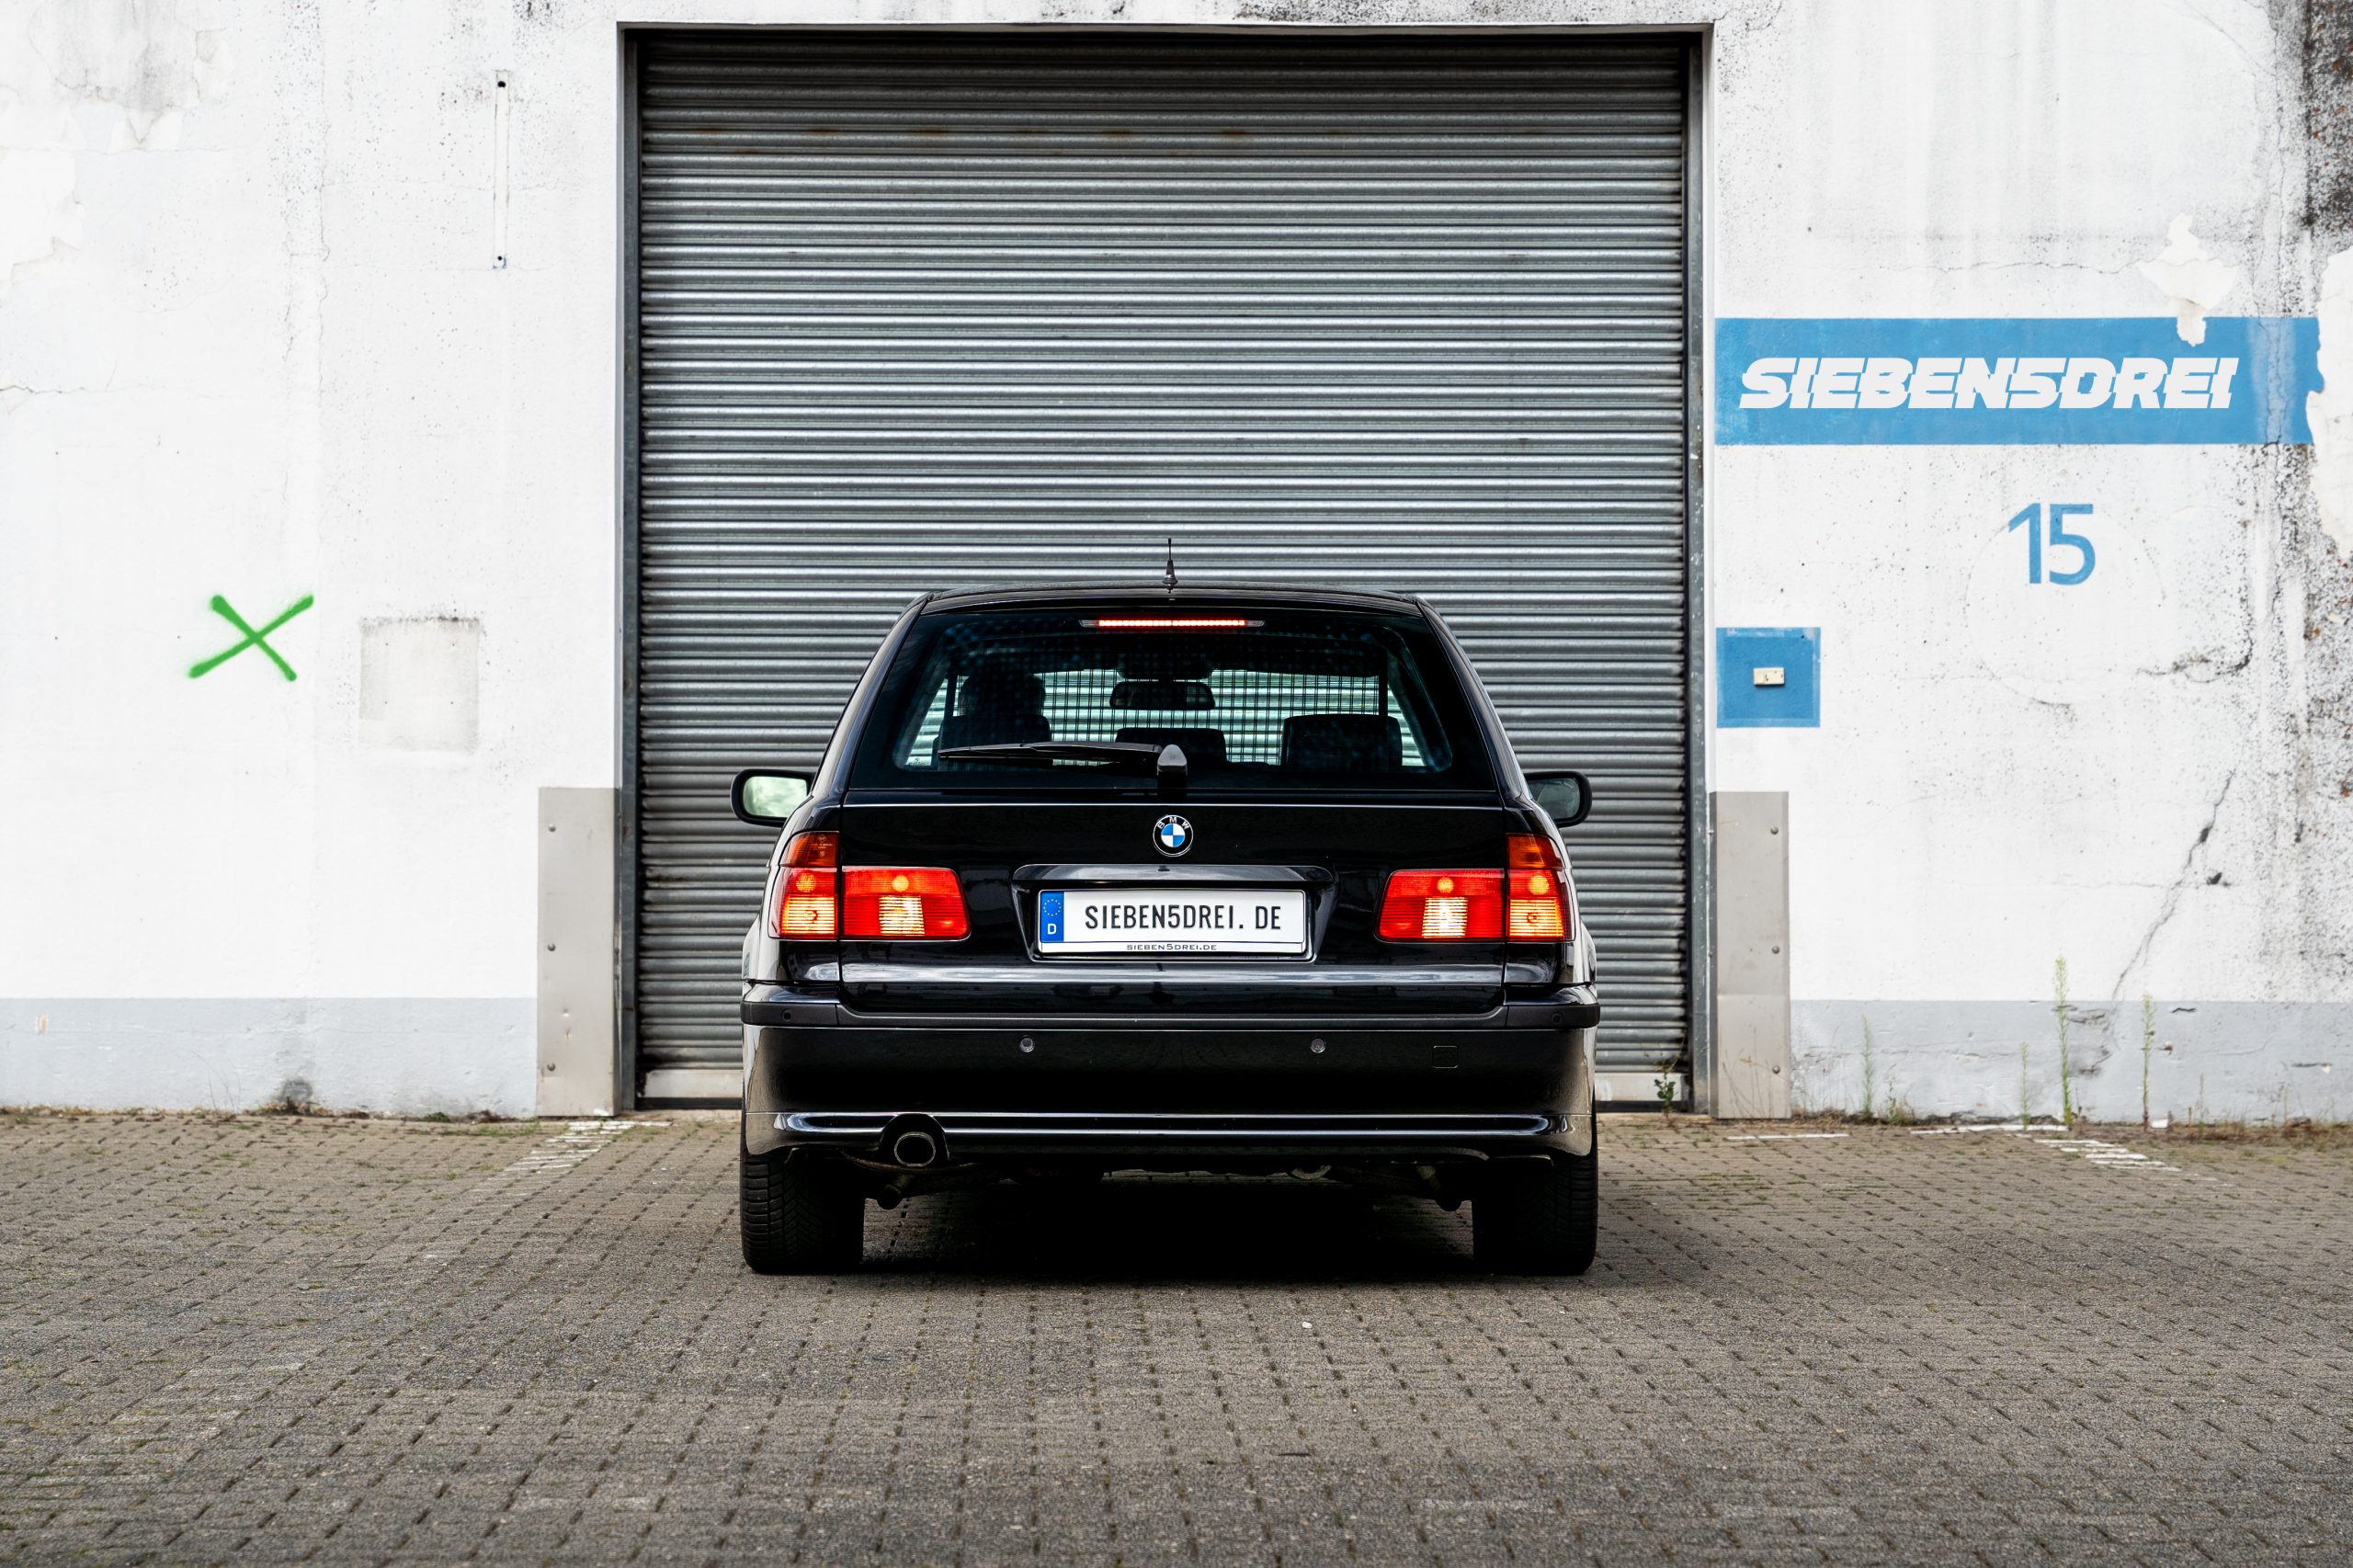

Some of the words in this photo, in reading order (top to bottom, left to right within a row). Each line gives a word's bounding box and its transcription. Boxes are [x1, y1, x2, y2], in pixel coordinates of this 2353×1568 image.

[2007, 503, 2096, 585] 15
[1156, 816, 1191, 830] BMW
[1047, 923, 1057, 935] D
